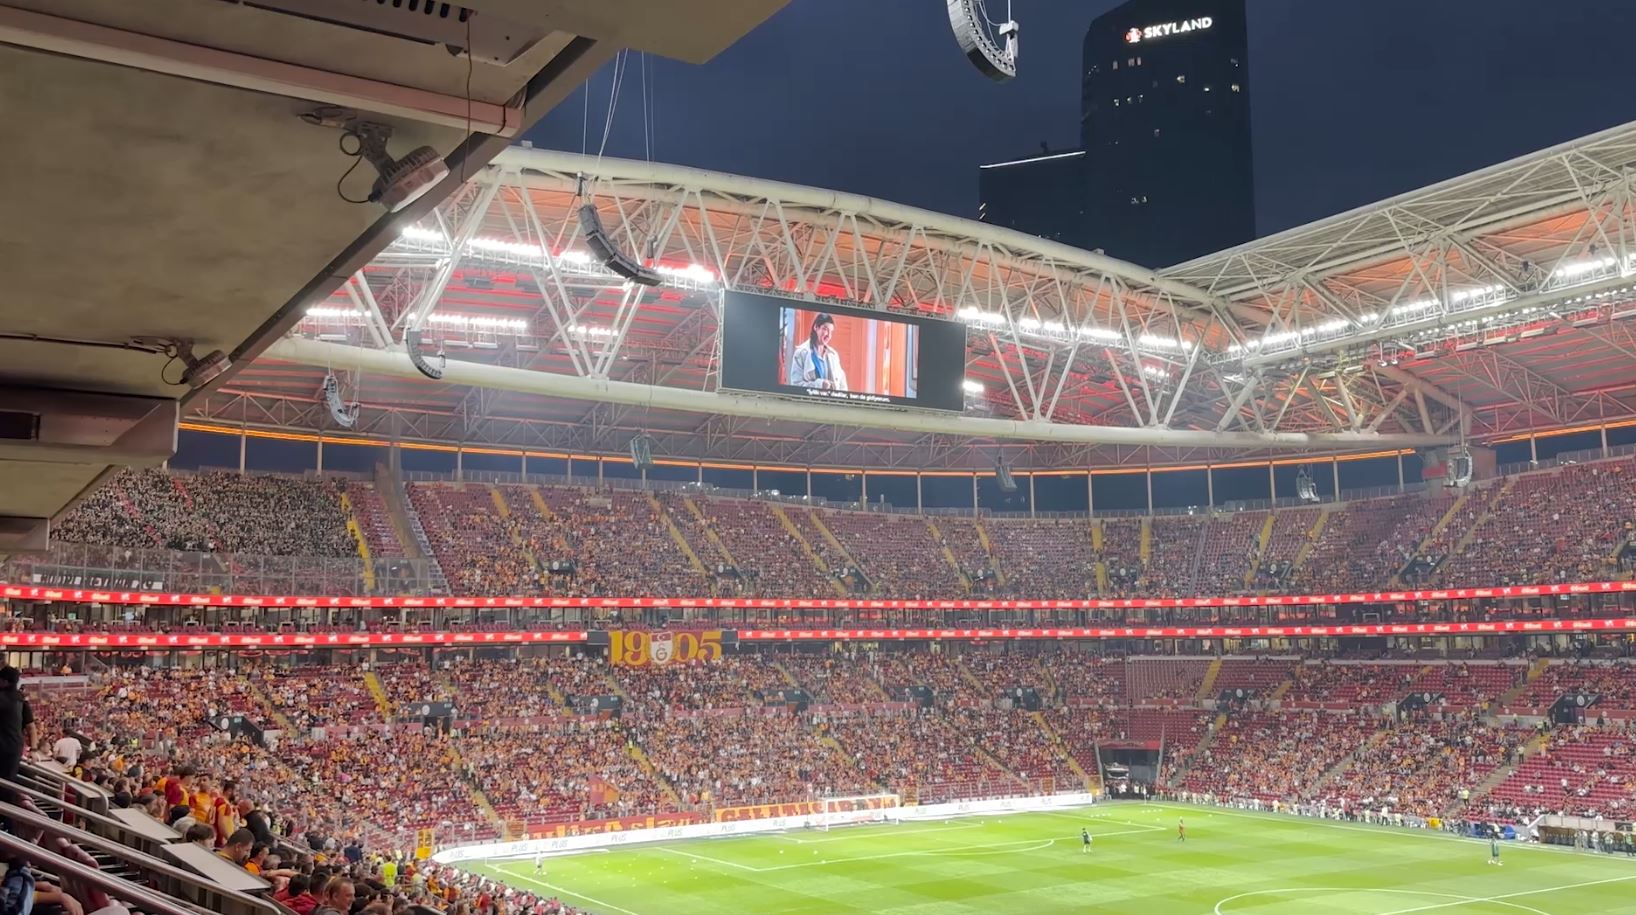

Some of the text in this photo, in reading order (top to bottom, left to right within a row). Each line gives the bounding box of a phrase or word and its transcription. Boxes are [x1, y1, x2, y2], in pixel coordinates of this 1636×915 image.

[1143, 17, 1213, 39] SKYLAND
[608, 631, 722, 666] 1905
[511, 842, 528, 851] PLUS
[552, 839, 568, 848] PLUS
